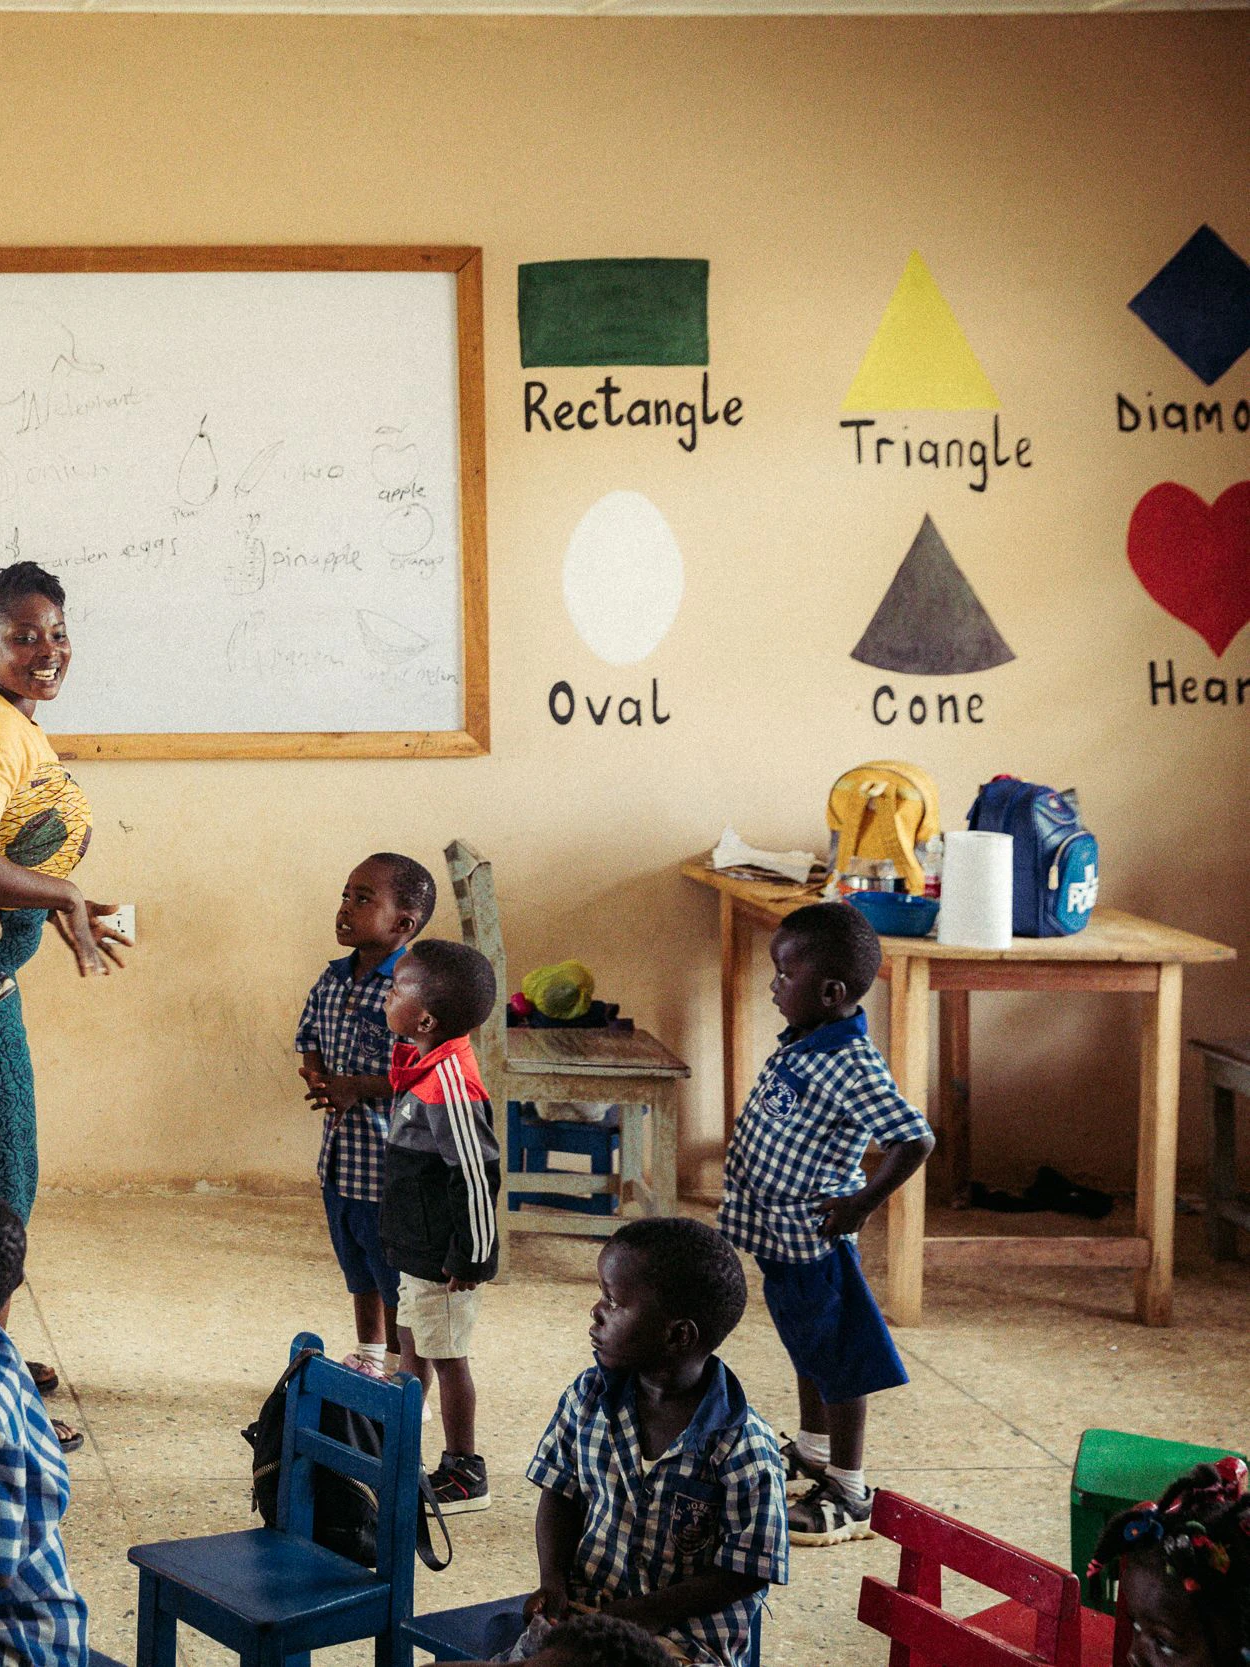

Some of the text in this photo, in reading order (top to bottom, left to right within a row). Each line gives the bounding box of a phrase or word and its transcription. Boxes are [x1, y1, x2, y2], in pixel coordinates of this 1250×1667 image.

[524, 371, 744, 453] Rectangle
[840, 415, 1032, 493] Triangle
[378, 482, 427, 503] apple
[548, 679, 670, 726] Oval
[873, 685, 984, 725] Cone
